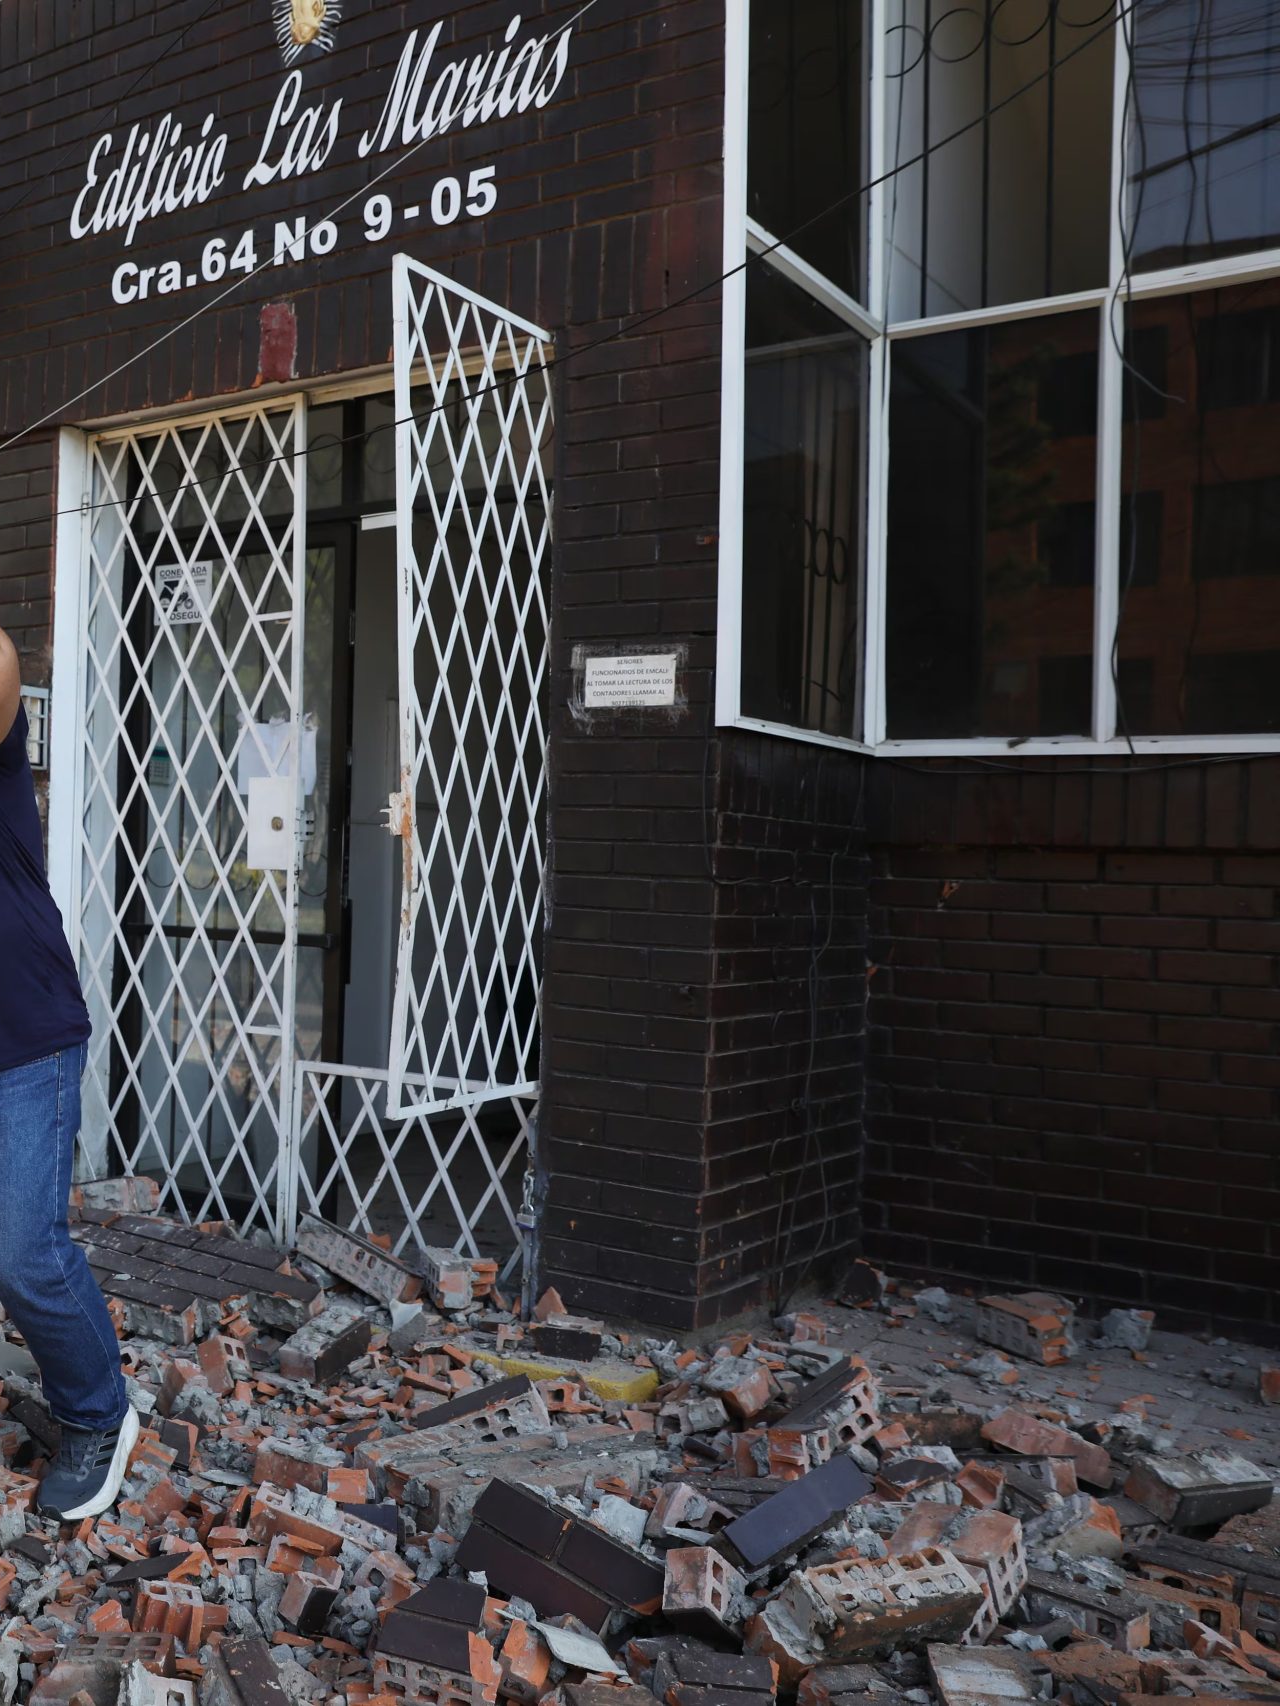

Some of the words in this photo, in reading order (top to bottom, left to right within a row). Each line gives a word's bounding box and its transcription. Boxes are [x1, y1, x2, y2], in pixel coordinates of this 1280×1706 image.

[69, 112, 228, 247] Edificio
[242, 69, 343, 191] Las
[111, 229, 258, 305] Cra.64
[273, 216, 339, 267] No
[159, 566, 207, 577] CONEADA
[591, 668, 636, 676] FUNCIONARIOS
